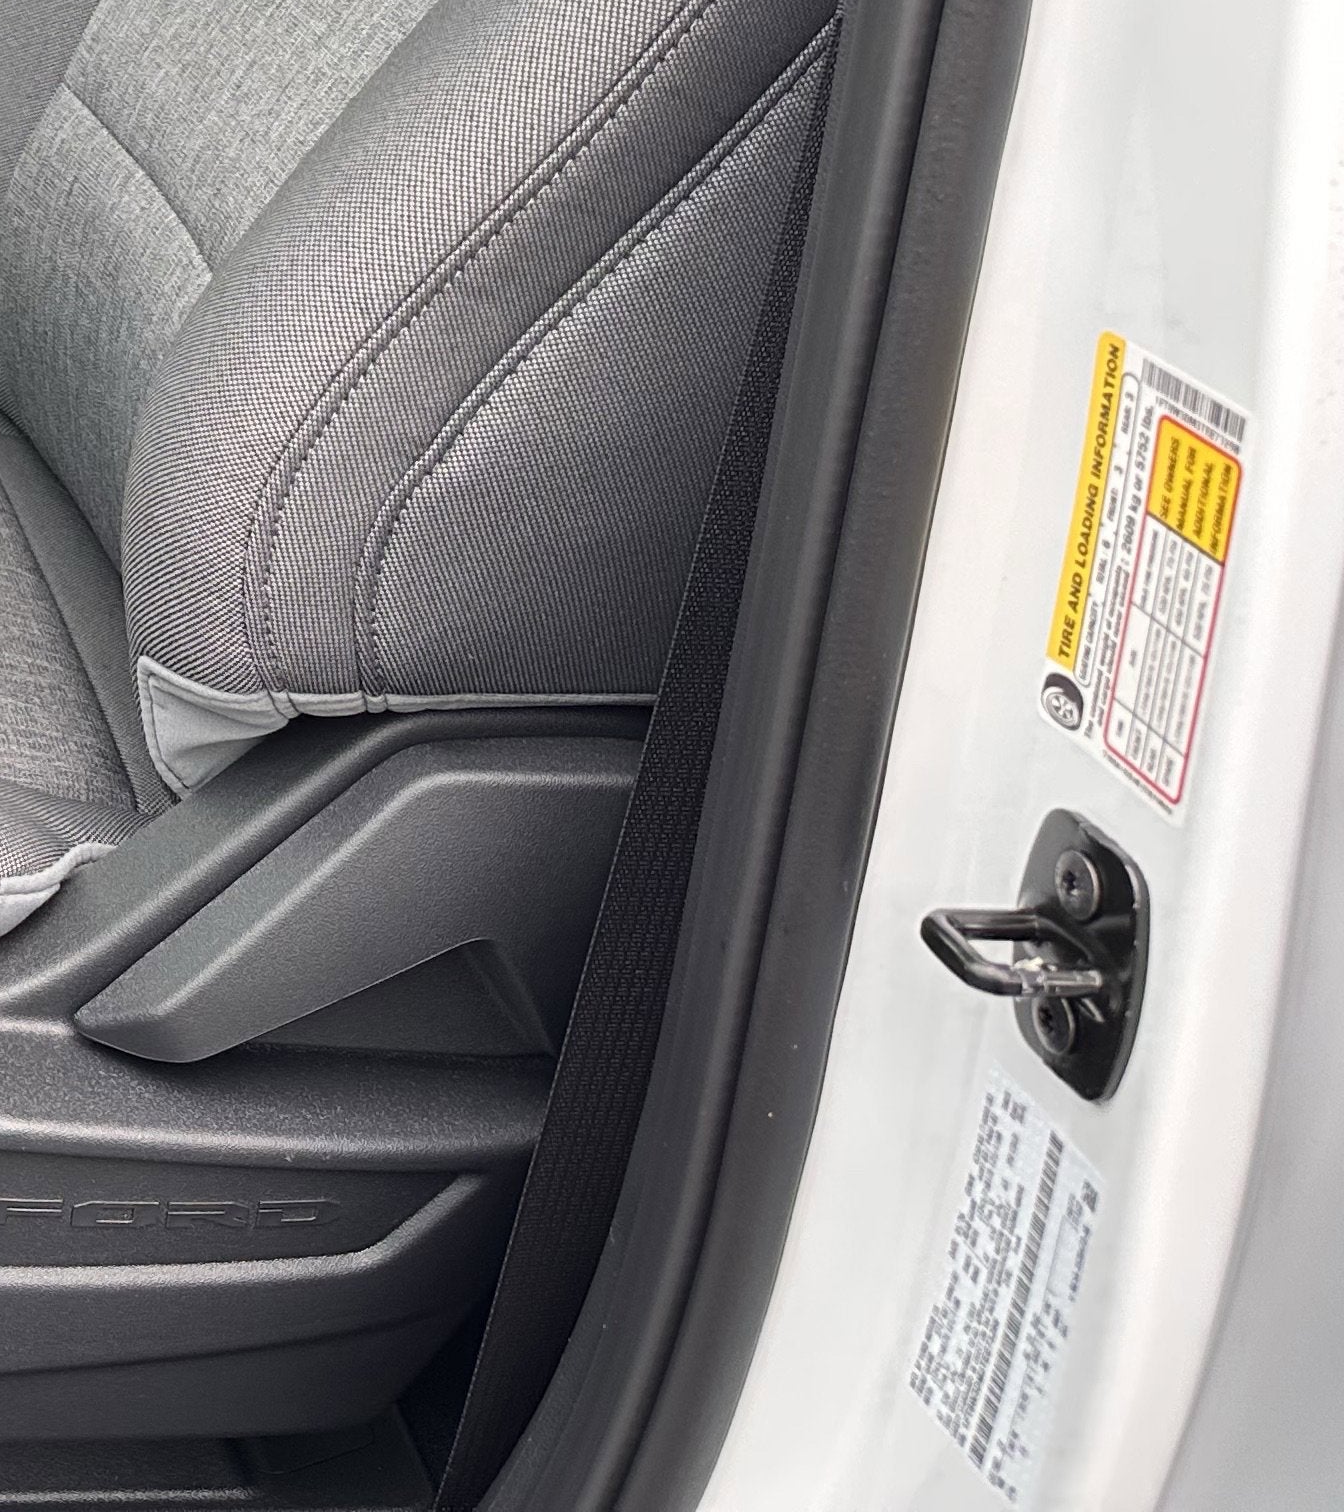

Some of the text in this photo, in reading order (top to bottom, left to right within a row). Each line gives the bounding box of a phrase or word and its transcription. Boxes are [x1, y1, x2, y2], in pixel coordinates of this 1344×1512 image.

[1134, 429, 1149, 472] 5752
[1057, 343, 1120, 659] TIRE AND LOADING INFORMATION
[1127, 490, 1141, 516] kg
[1134, 472, 1144, 493] or
[1121, 512, 1136, 555] 2609
